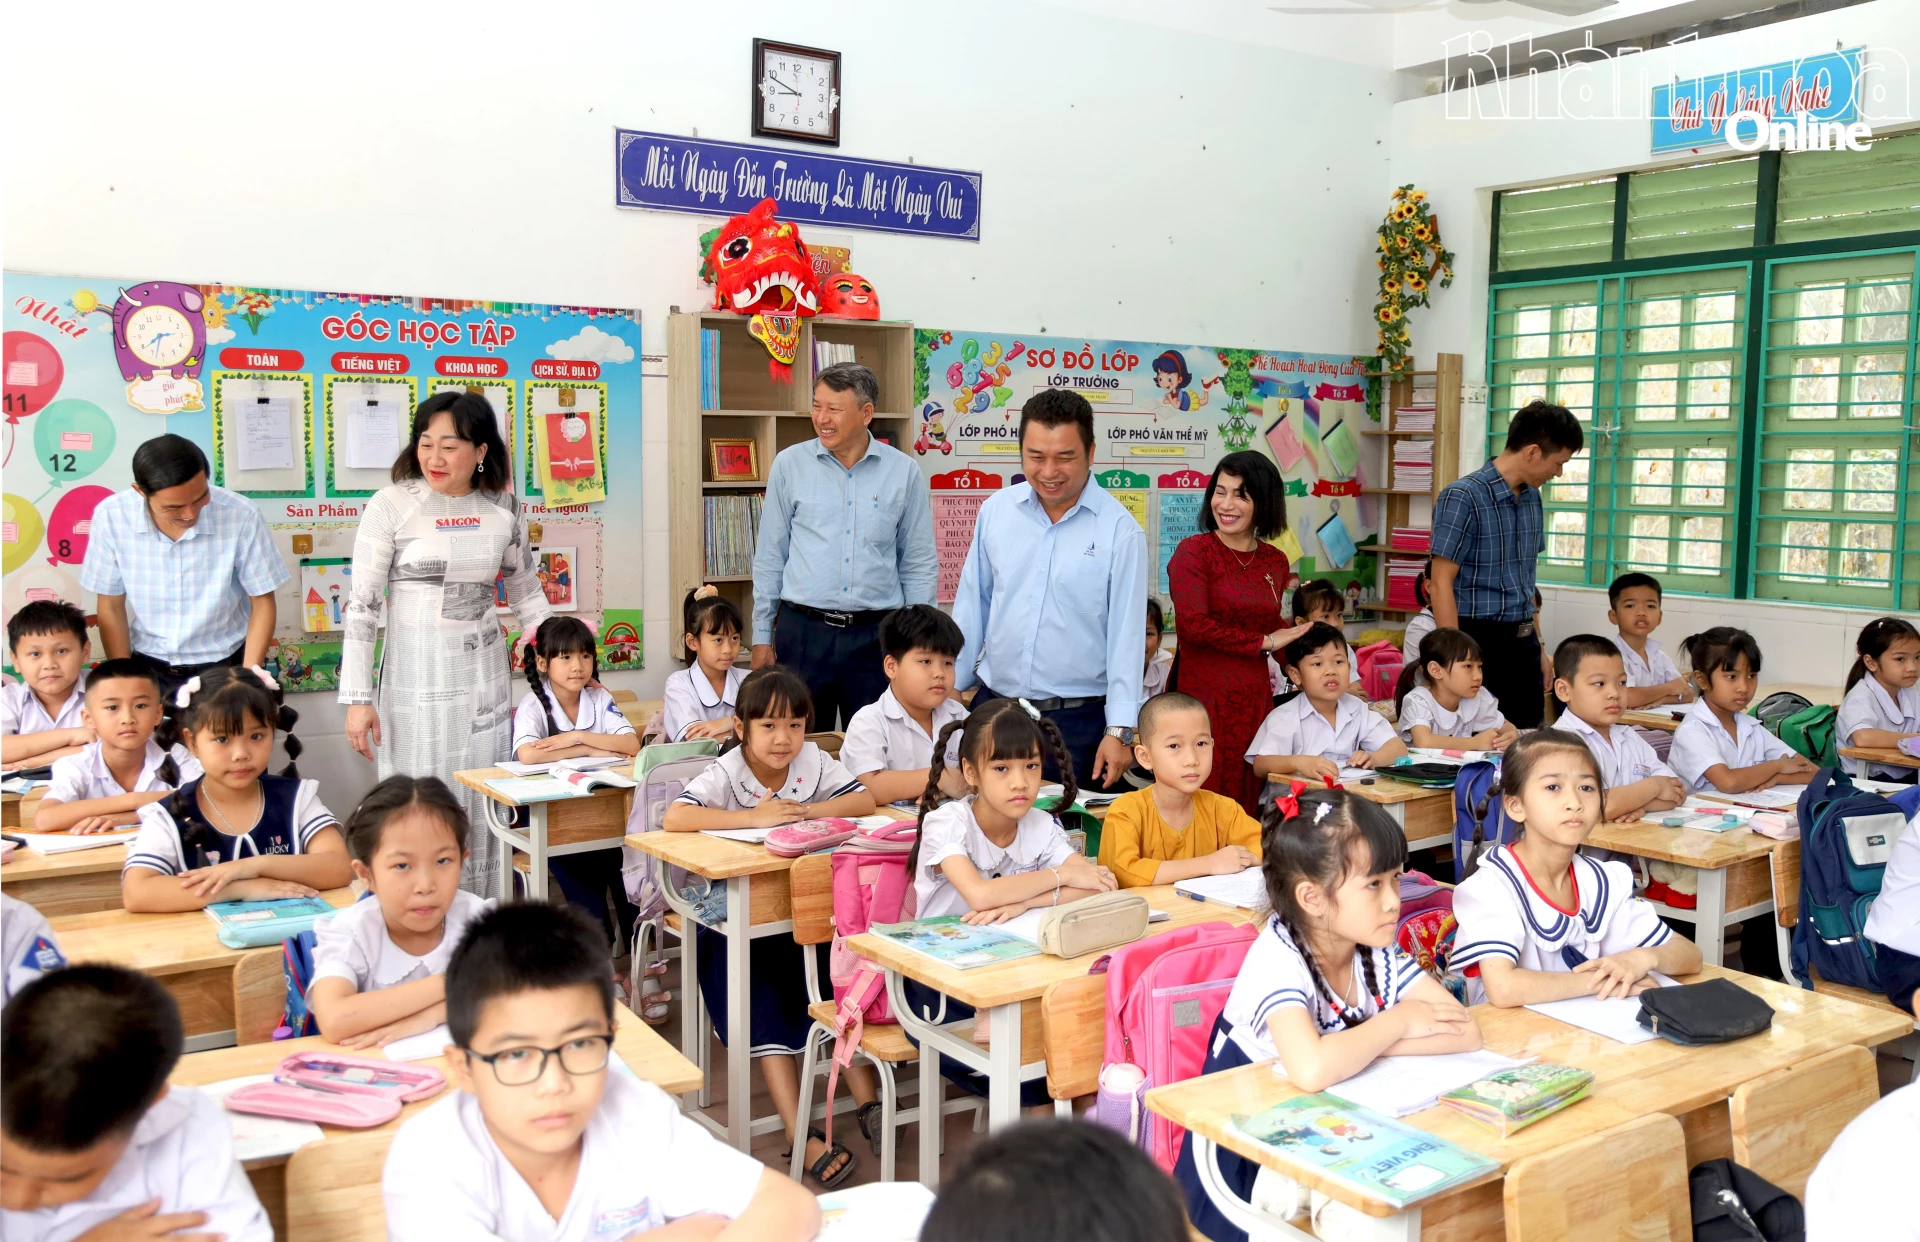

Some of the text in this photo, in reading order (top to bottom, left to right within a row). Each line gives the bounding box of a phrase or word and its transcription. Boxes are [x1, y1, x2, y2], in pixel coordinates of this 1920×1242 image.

[778, 62, 786, 71] 11
[792, 64, 802, 73] 12
[810, 66, 814, 76] 1
[768, 69, 778, 79] 10
[818, 77, 825, 87] 2
[769, 85, 775, 95] 9
[818, 94, 824, 103] 3
[768, 103, 775, 113] 8
[1671, 96, 1703, 132] Chú
[779, 113, 786, 122] 7
[793, 116, 799, 125] 6
[817, 111, 824, 119] 4
[808, 117, 814, 127] 5
[640, 145, 676, 190] Mỗi
[680, 149, 729, 204] Ngày
[733, 156, 767, 199] Đến
[772, 160, 829, 215] Trường
[832, 168, 855, 209] Là
[857, 171, 887, 219] Một
[891, 175, 932, 225] Ngày
[14, 295, 89, 341] Nhật
[321, 313, 517, 353] GÓC HỌC TẬP
[246, 354, 279, 367] TOÁN
[1026, 342, 1139, 372] SƠ ĐỒ LỚP
[340, 354, 402, 374] TIẾNG VIỆT
[446, 361, 499, 377] KHOA HỌC
[1270, 357, 1295, 374] Hoạch
[1297, 359, 1317, 374] Hoạt
[1318, 360, 1338, 379] Động
[534, 363, 554, 378] LỊCH
[571, 365, 587, 379] ĐỊA
[588, 363, 598, 377] LÝ
[1047, 373, 1120, 388] LỚP TRƯỞNG
[162, 382, 175, 392] giờ
[1277, 385, 1292, 396] Tổ 1
[1332, 388, 1347, 398] Tổ 2
[3, 393, 27, 412] 11
[165, 396, 184, 406] phút
[959, 423, 981, 437] LỚP
[983, 424, 1007, 438] PHÓ
[1108, 426, 1208, 441] LỚP PHÓ VĂN THỂ MỸ
[49, 453, 77, 472] 12
[954, 471, 981, 489] TỔ 1
[1106, 472, 1132, 487] TỔ 3
[1176, 472, 1200, 488] TỔ 4
[1285, 484, 1290, 494] 3
[1330, 483, 1345, 494] Tổ 4
[286, 502, 314, 518] Sản
[318, 501, 358, 518] Phẩm
[58, 539, 72, 558] 8
[943, 551, 963, 559] MINH
[939, 562, 961, 571] NGỌC
[265, 843, 290, 855] LUCKY
